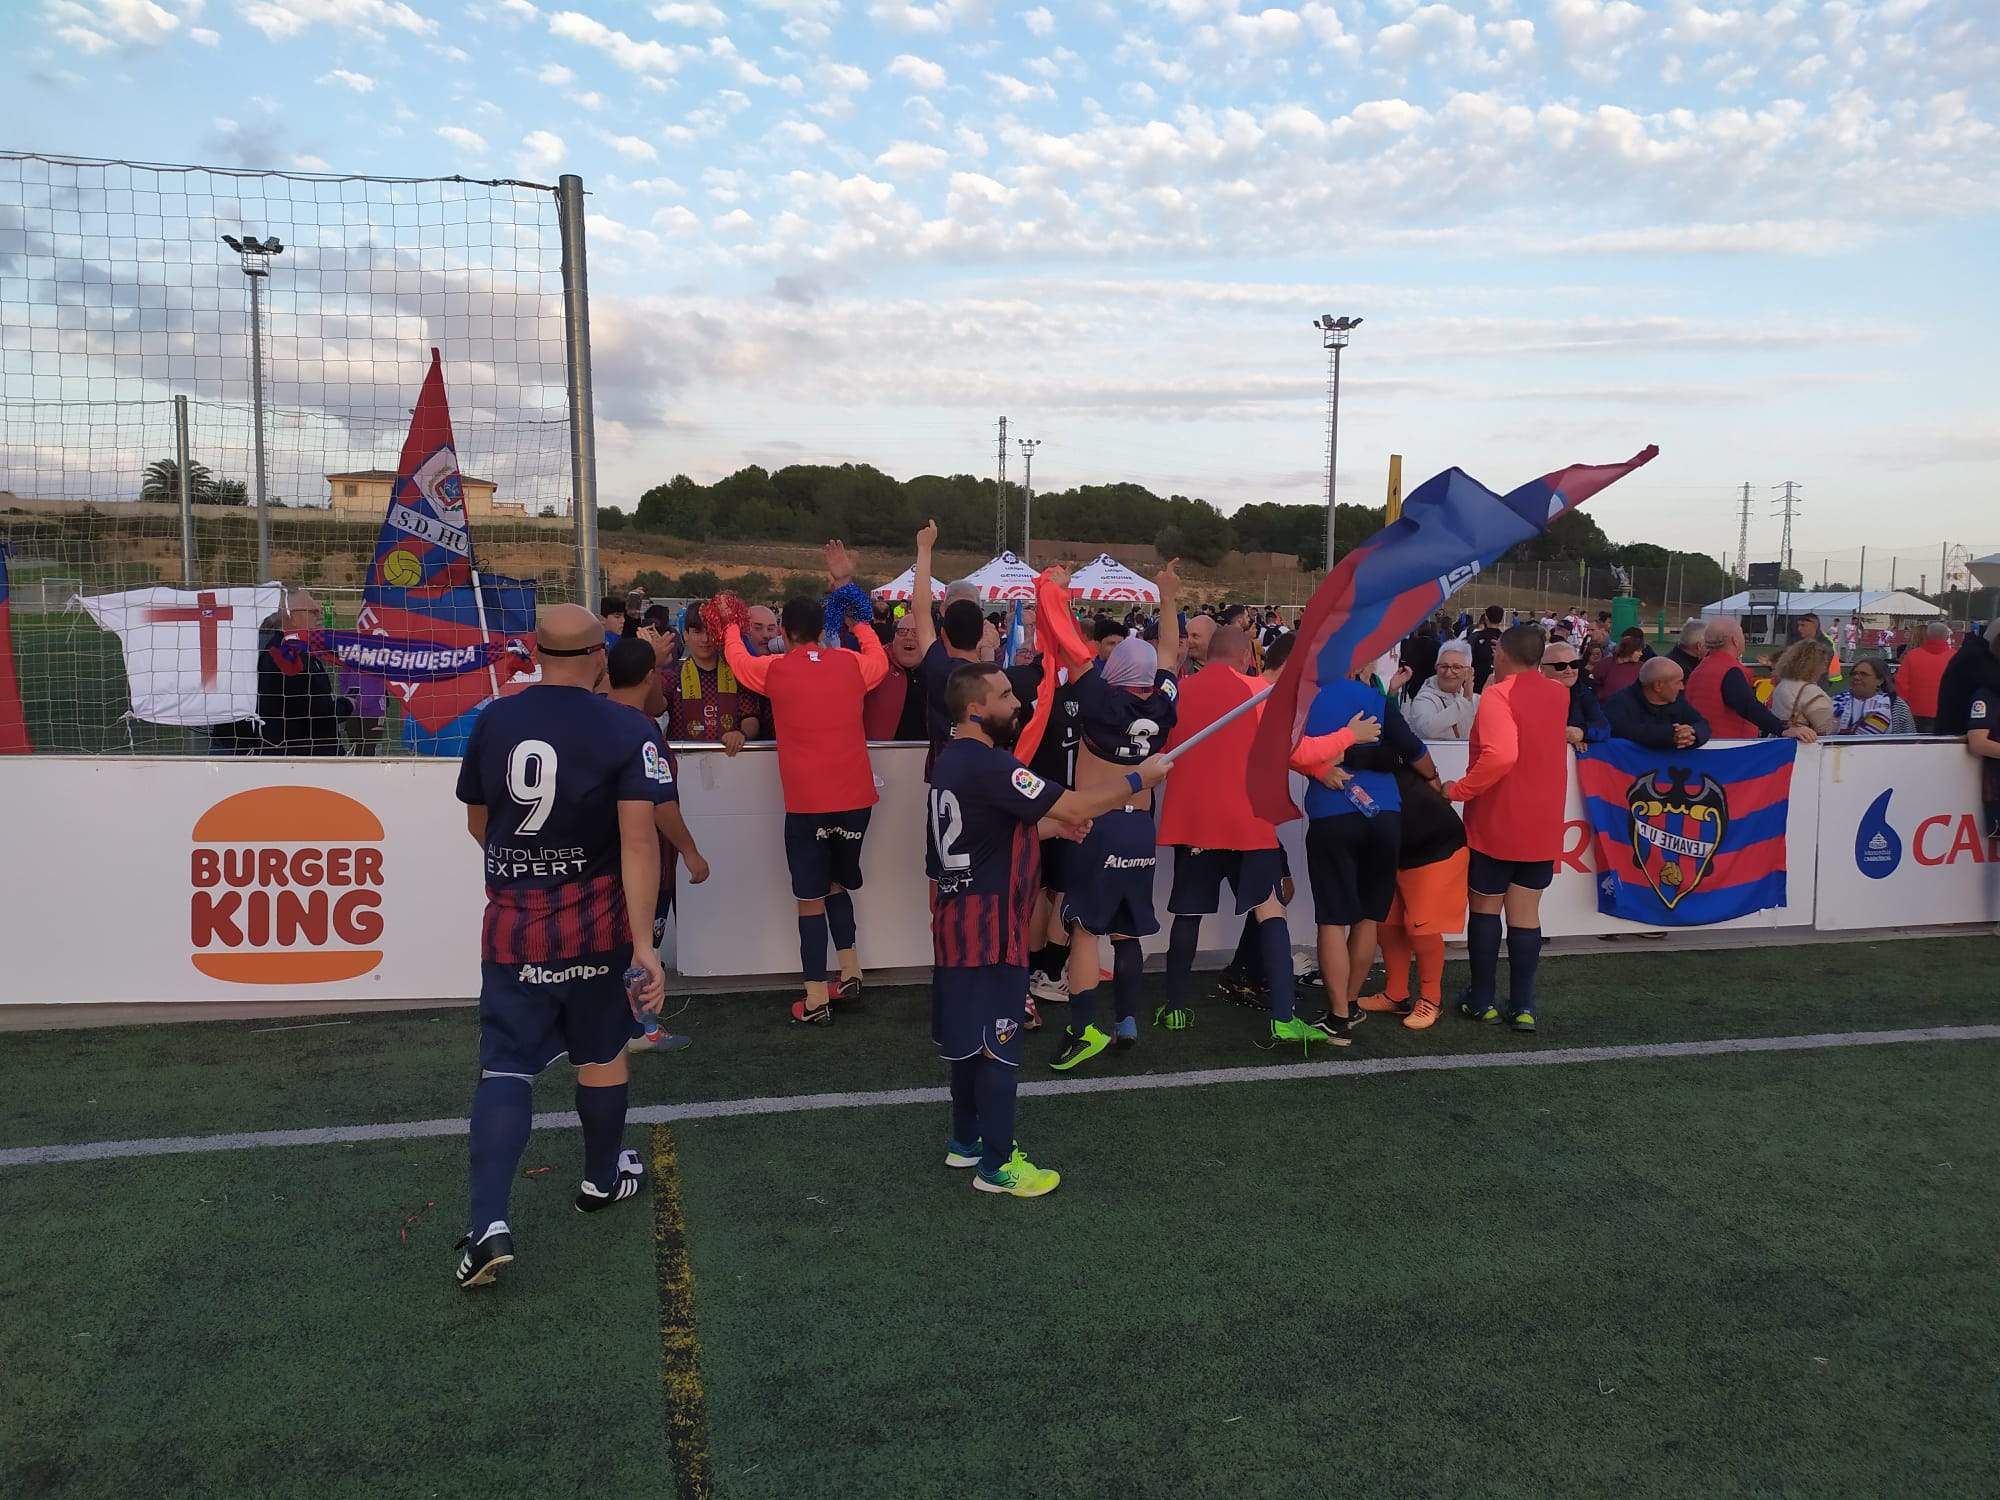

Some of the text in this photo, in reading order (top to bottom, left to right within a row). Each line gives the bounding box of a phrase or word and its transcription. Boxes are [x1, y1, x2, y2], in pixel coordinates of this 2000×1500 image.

[397, 511, 432, 536] S.D.
[337, 643, 476, 670] VAMOSHUESCA
[1115, 718, 1160, 758] 3
[506, 739, 558, 836] 9
[930, 788, 971, 871] 12
[487, 843, 585, 862] AUTOLÍDER
[1104, 854, 1156, 869] Alcampo
[191, 847, 385, 888] BURGER
[487, 858, 588, 878] EXPERT
[191, 889, 385, 947] KING
[519, 964, 610, 984] Alcampo
